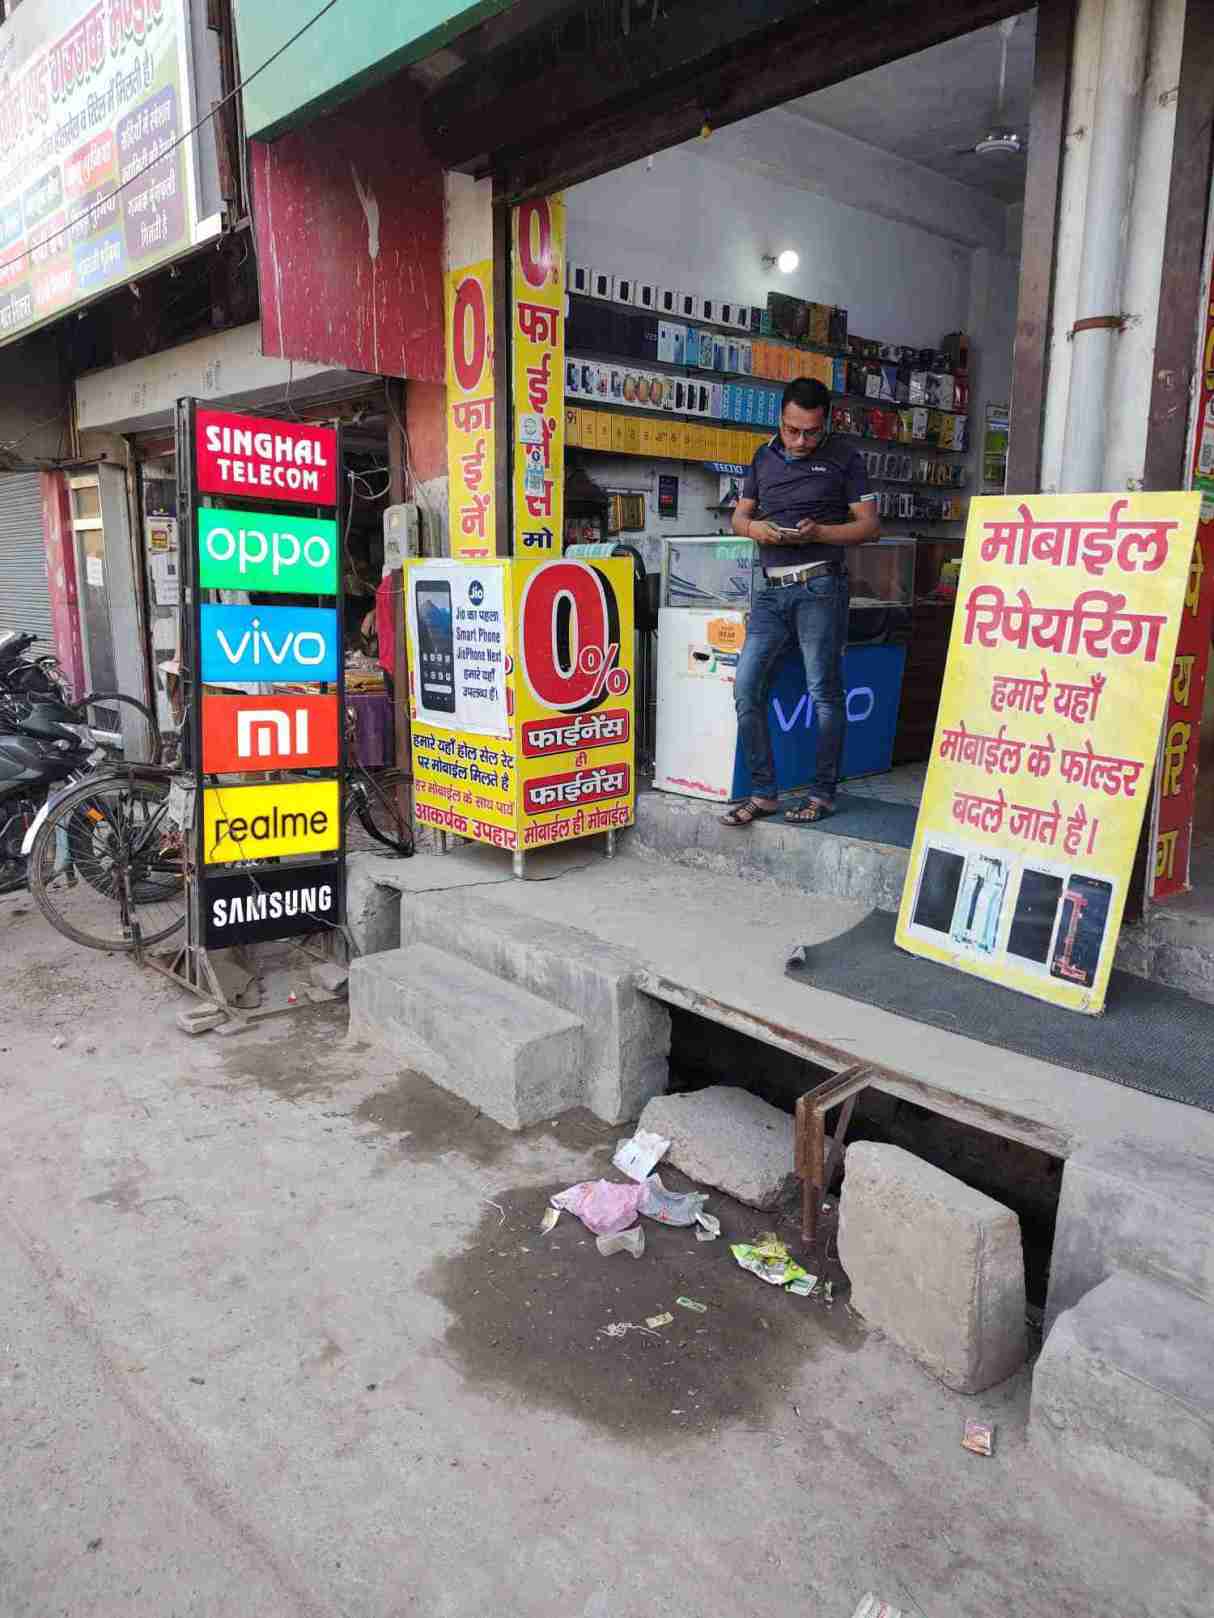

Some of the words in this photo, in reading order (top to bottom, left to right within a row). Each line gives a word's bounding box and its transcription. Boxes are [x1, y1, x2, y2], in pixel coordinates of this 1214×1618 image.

[205, 425, 327, 466] SINGHAL
[216, 458, 319, 491] TELECOM
[980, 499, 1178, 576] मोबाईल
[216, 618, 326, 666] vivo
[456, 626, 477, 641] Smart
[478, 628, 501, 643] Phone
[519, 559, 629, 713] 0%
[963, 584, 1168, 662] रिपेयरिंग
[772, 686, 875, 732] vio
[991, 667, 1051, 715] हमारे
[1054, 672, 1107, 724] यहाँ
[528, 711, 625, 749] फाईनेंस
[412, 734, 436, 751] हमारे
[457, 740, 477, 761] होल
[479, 747, 498, 767] सेल
[501, 750, 514, 769] रेट
[417, 754, 429, 770] पर
[575, 751, 588, 768] ही
[939, 725, 1026, 776] मोबाईल
[1028, 732, 1056, 778] के
[1060, 739, 1144, 797] फोल्डर
[529, 766, 625, 805] फाईनेंस
[215, 805, 329, 846] realme
[415, 802, 469, 833] आकर्षक
[471, 818, 518, 849] उपहार
[524, 817, 570, 844] मोबाईल
[570, 812, 585, 833] ही
[586, 805, 629, 829] मोबाईल
[952, 788, 1007, 833] बदले
[1008, 800, 1061, 845] जाते
[212, 884, 332, 928] SAMSUNG
